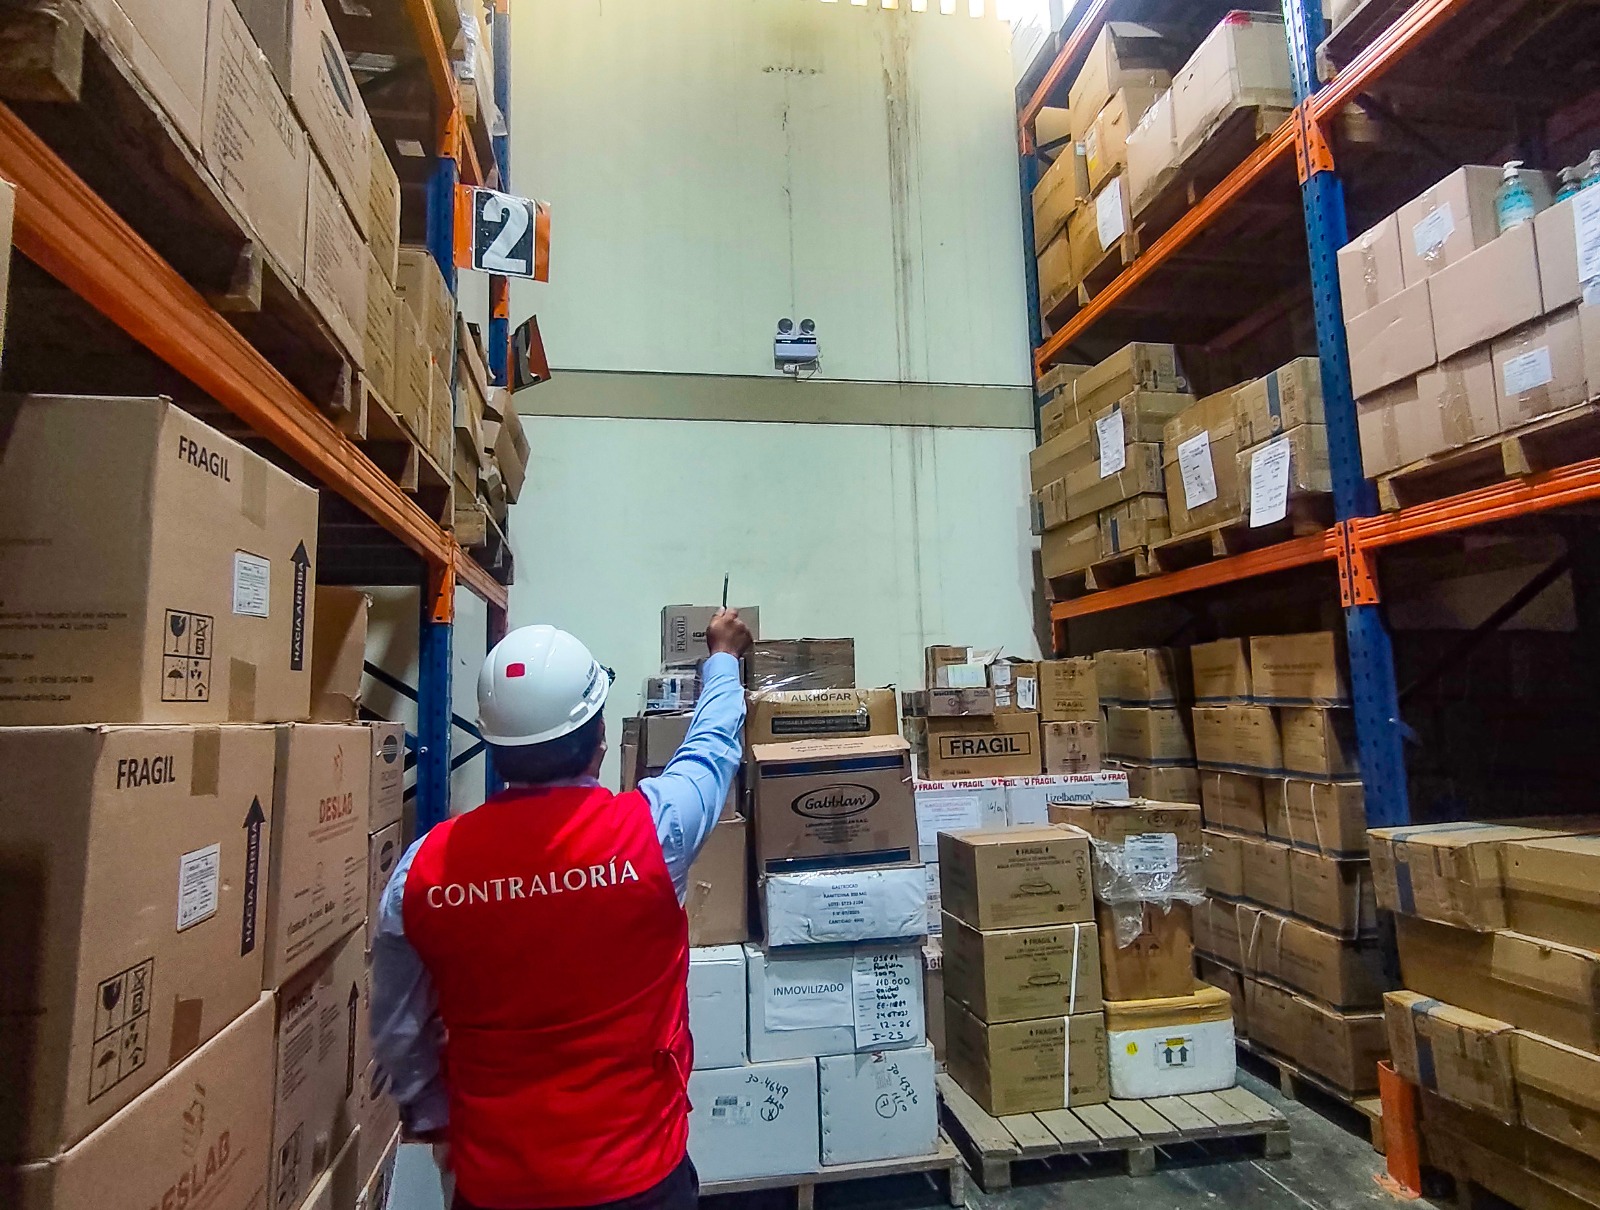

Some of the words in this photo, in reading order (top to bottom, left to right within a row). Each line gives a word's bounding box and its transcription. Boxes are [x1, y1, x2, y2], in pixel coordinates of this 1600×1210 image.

[481, 194, 529, 274] 2
[177, 434, 232, 483] FRAGIL
[296, 562, 304, 614] ARRIBA
[676, 616, 686, 651] FRAGIL
[791, 692, 852, 702] ALKHOFAR
[950, 736, 1021, 755] FRAGIL
[116, 755, 176, 790] FRAGIL
[959, 781, 984, 789] FRAGIL
[1031, 777, 1057, 786] FRAGIL
[1070, 775, 1095, 784] FRAGIL
[918, 783, 945, 791] FRAGIL
[248, 821, 258, 885] ARRIBA
[427, 855, 640, 909] CONTRALORÍA
[773, 982, 845, 997] INMOVILIZADO
